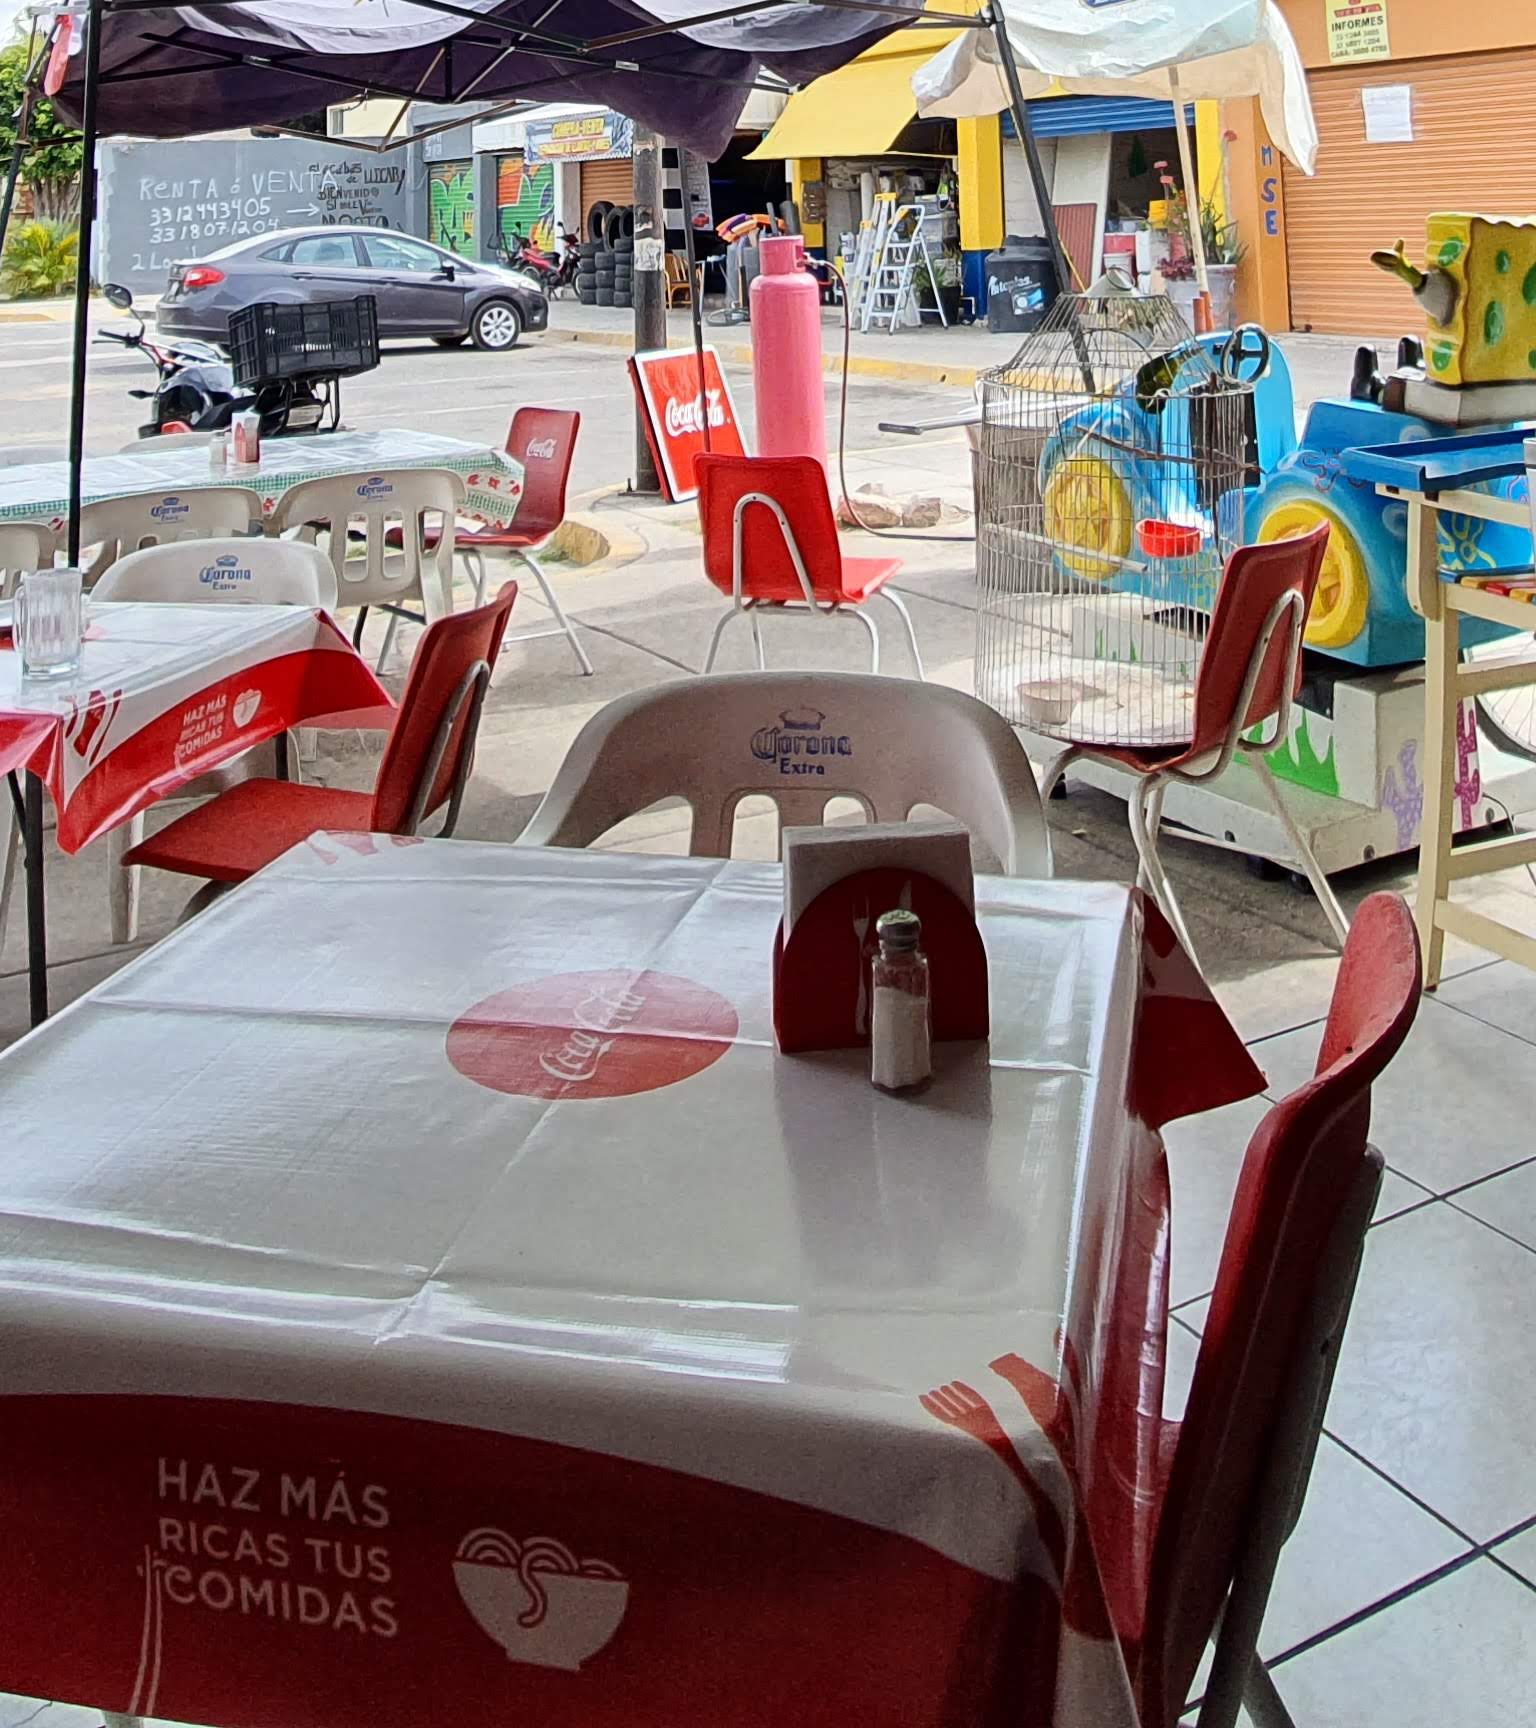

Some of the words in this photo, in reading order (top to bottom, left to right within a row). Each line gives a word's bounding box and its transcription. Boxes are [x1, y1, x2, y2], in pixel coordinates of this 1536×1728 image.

[1331, 16, 1384, 32] INFORMES
[252, 170, 339, 196] VENTA
[131, 253, 145, 271] 2
[199, 566, 251, 583] Corona
[750, 726, 853, 763] Corona
[779, 758, 825, 775] Extra
[157, 1457, 261, 1512] HAZ
[280, 1471, 390, 1528] MÁS
[159, 1517, 291, 1568] RICAS
[305, 1538, 392, 1583] TUS
[164, 1564, 399, 1638] COMIDAS
